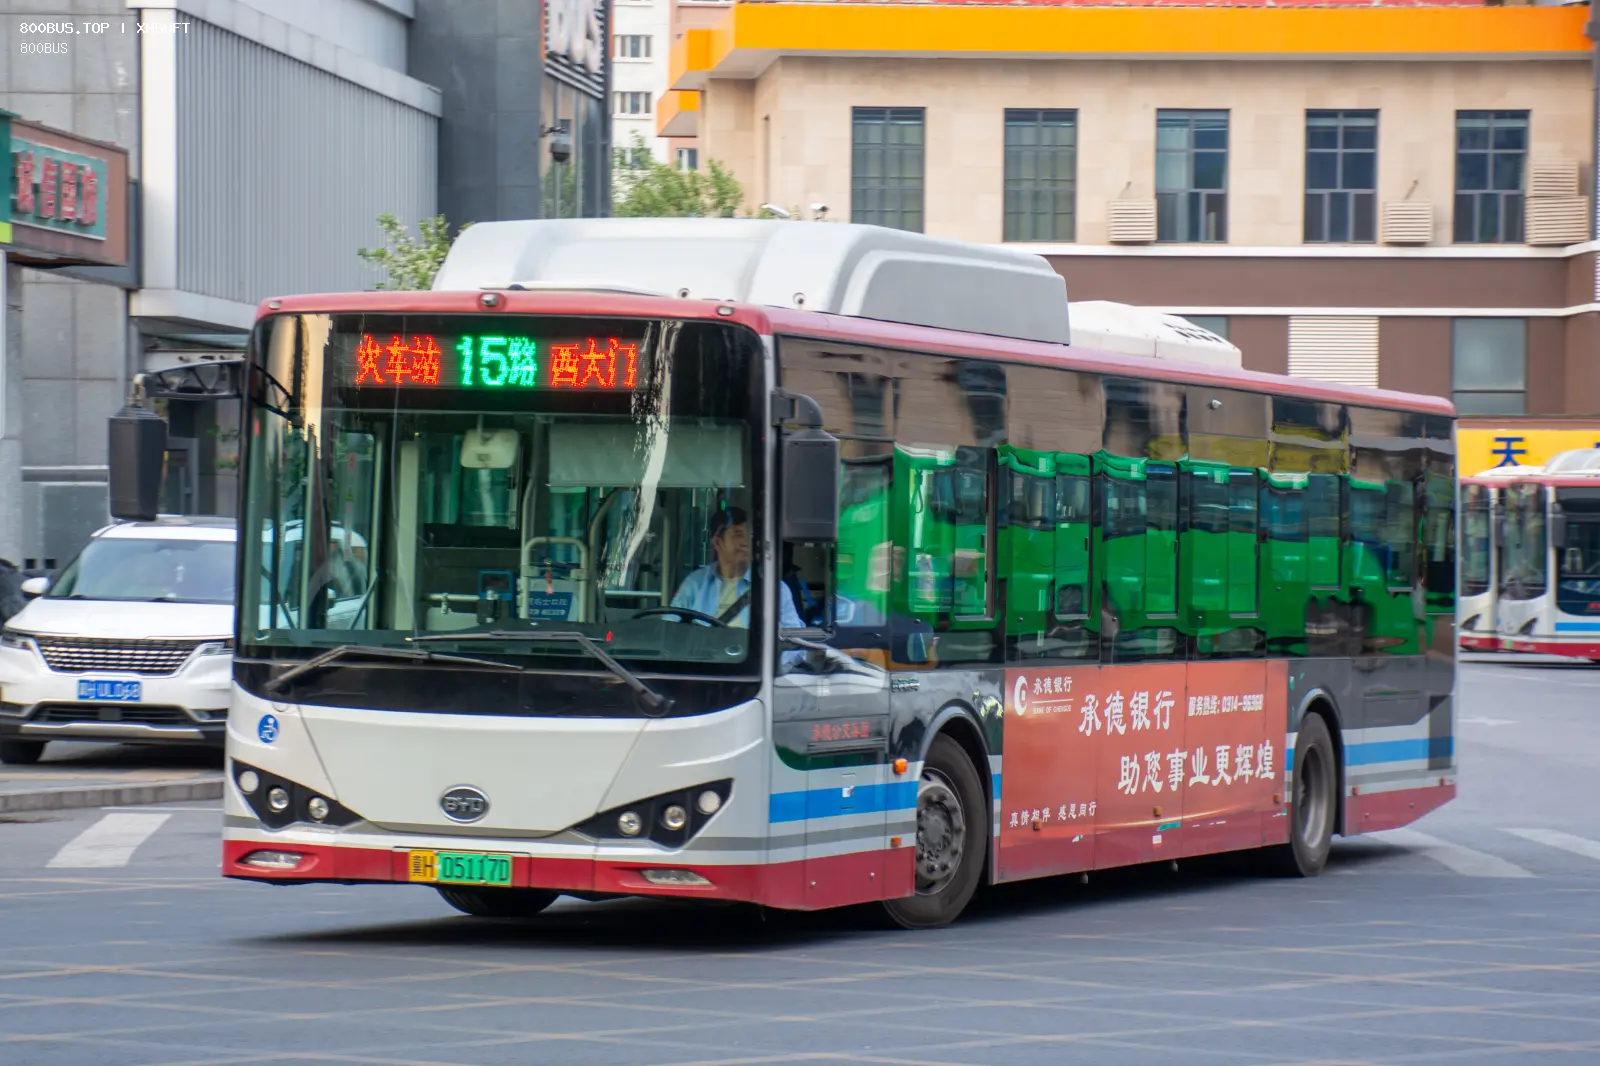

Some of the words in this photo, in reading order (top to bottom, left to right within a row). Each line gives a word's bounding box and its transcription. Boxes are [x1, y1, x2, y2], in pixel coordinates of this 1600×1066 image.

[354, 334, 442, 387] 火车站
[455, 335, 539, 388] 15路
[549, 337, 638, 389] 西大门
[1033, 676, 1073, 696] 承德银行
[1078, 690, 1176, 737] 承德银行
[1117, 739, 1276, 795] 助您事业更辉煌
[443, 796, 485, 813] BYD
[1010, 807, 1051, 828] 真情相伴
